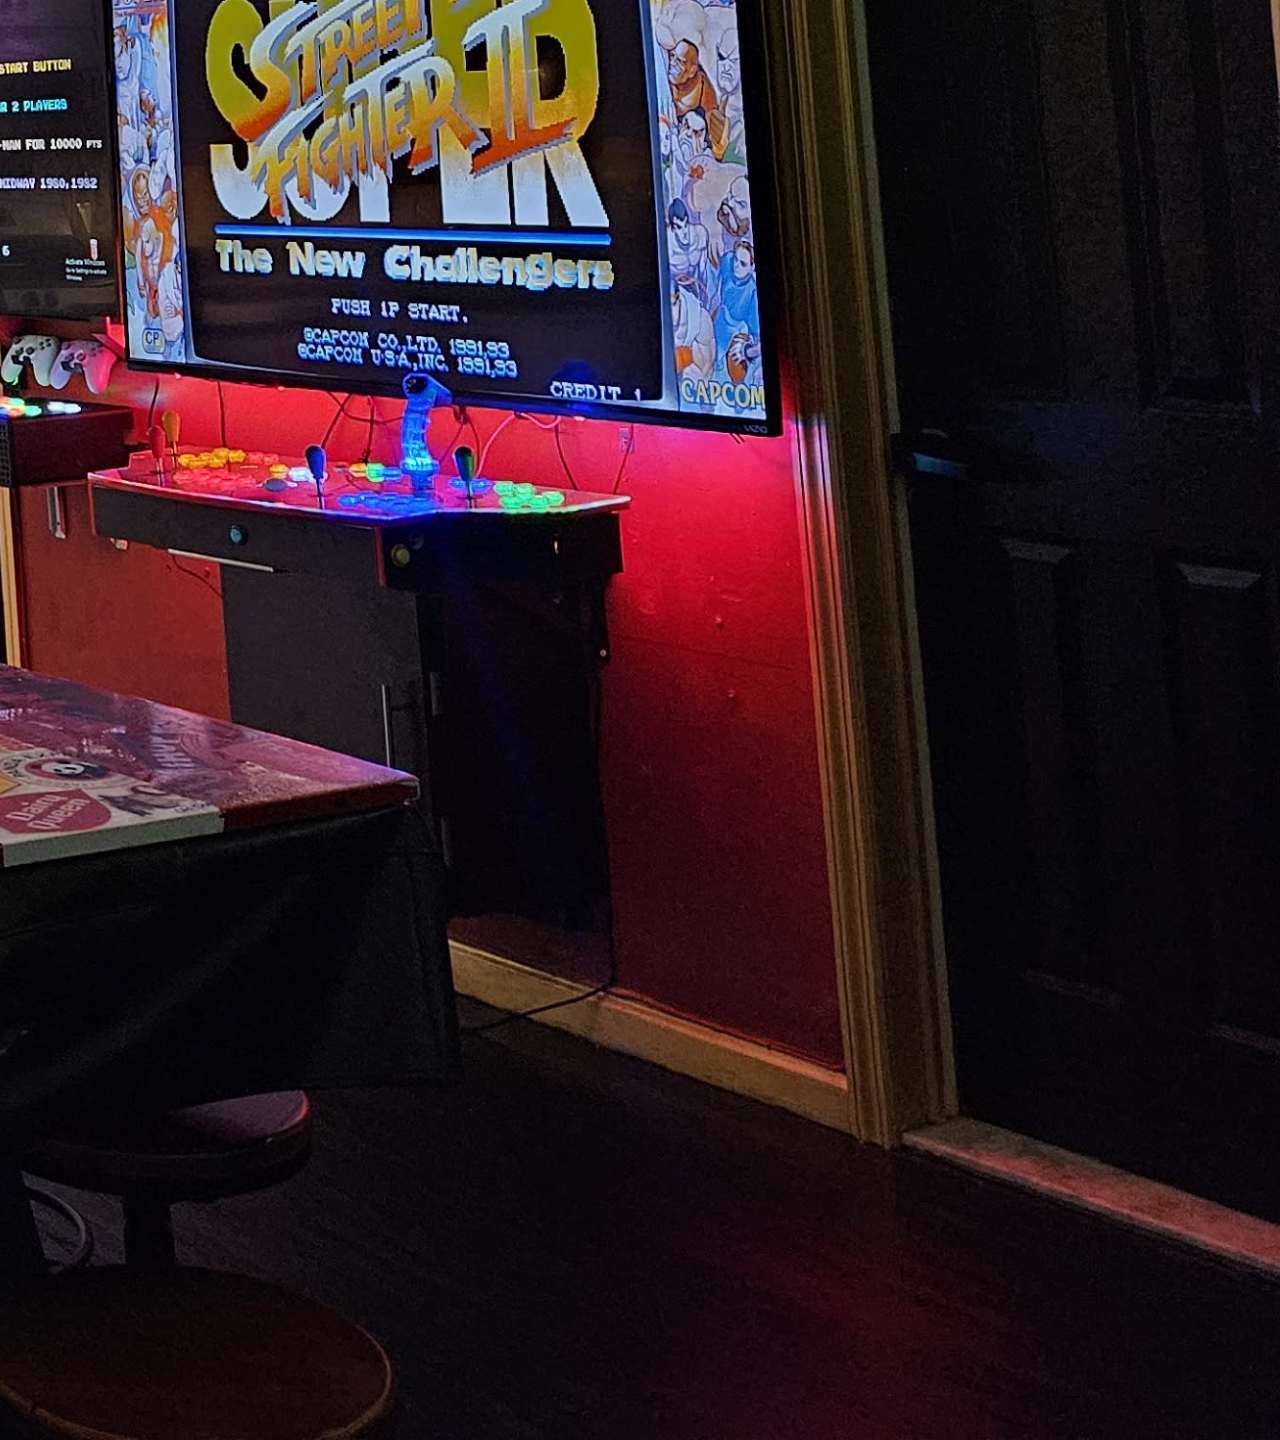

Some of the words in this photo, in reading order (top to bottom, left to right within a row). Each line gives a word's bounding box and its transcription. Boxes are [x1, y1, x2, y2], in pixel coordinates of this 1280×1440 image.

[33, 59, 72, 72] BUTTON
[12, 100, 20, 112] 2
[23, 99, 68, 111] PLAYERS
[251, 38, 489, 225] FIGHTER
[26, 139, 45, 150] FOR
[50, 138, 82, 150] 10000
[87, 140, 102, 148] PTS
[0, 178, 35, 189] MIDWAY
[215, 239, 274, 274] The
[285, 241, 366, 280] New
[384, 244, 615, 290] Challengers
[331, 298, 371, 317] PUSH
[381, 301, 400, 319] 1P
[550, 381, 622, 401] CREDIT
[681, 378, 765, 410] CAPCOM
[6, 793, 68, 821] Dairy
[28, 796, 91, 831] Queen
